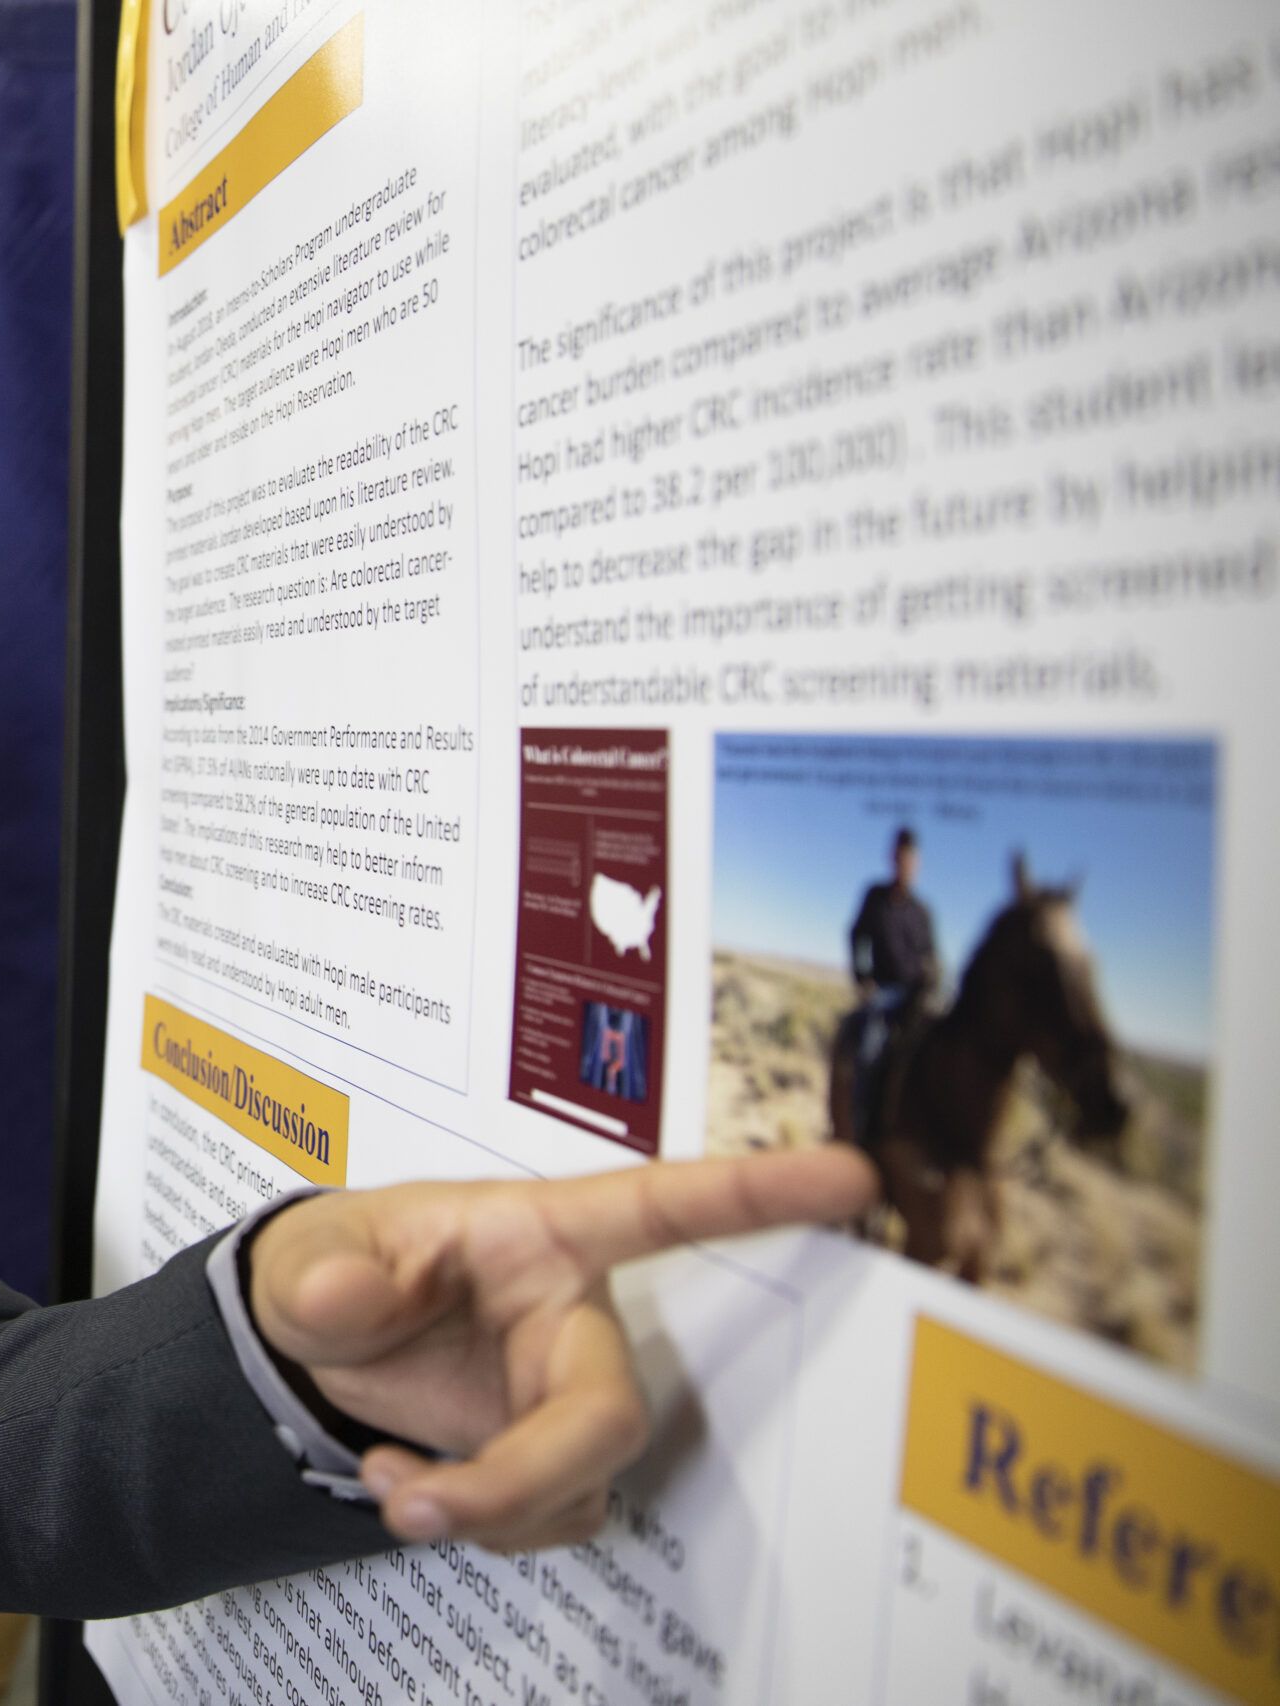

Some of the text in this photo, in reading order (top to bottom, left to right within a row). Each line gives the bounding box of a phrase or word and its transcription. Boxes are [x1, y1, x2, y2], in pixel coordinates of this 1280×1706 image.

[222, 37, 262, 101] Human
[172, 173, 228, 250] Abstract
[290, 265, 331, 306] extensive
[333, 230, 381, 277] literature
[384, 205, 424, 245] review
[428, 189, 447, 219] for
[295, 167, 417, 264] Program undergraduate
[519, 182, 616, 261] colorectal
[273, 229, 450, 351] for the Hopi navigator to use while
[518, 244, 775, 372] The significance of this
[259, 278, 439, 395] audience were Hopi men who are 50
[518, 289, 853, 429] cancer burden compared to
[276, 394, 296, 422] Hopi
[297, 369, 356, 412] Reservation.
[268, 404, 459, 497] to evaluate the readability of the CRC
[518, 440, 561, 485] Hopi
[565, 425, 606, 472] had
[610, 413, 684, 466] higher
[689, 386, 742, 440] CRC
[285, 497, 311, 527] based
[314, 495, 337, 523] upon
[340, 481, 354, 510] his
[357, 472, 408, 506] literature
[411, 457, 455, 489] review.
[518, 460, 758, 541] compared to 38.2 per
[251, 543, 288, 571] materials
[290, 538, 309, 562] that
[311, 534, 334, 556] were
[336, 521, 366, 550] easily
[369, 501, 435, 542] understood
[438, 499, 453, 530] by
[518, 558, 558, 598] help
[561, 560, 583, 589] to
[588, 545, 690, 586] decrease
[694, 530, 739, 571] the
[748, 528, 798, 573] gap
[811, 519, 839, 553] in
[265, 593, 440, 639] read and understood by the target
[277, 576, 316, 606] question
[317, 572, 328, 594] is:
[330, 569, 348, 592] Are
[350, 553, 404, 588] colorectal
[407, 550, 453, 578] cancer-
[520, 613, 631, 651] understand
[634, 604, 673, 641] the
[683, 597, 843, 644] importance
[520, 672, 540, 707] of
[544, 667, 711, 707] understandable
[719, 662, 774, 705] CRC
[271, 725, 327, 747] Government
[330, 724, 397, 750] Performance
[400, 724, 422, 750] and
[426, 724, 474, 752] Results
[297, 767, 320, 785] were
[323, 769, 335, 791] up
[337, 767, 348, 788] to
[350, 764, 375, 790] date
[378, 766, 401, 792] with
[405, 768, 430, 794] CRC
[268, 797, 461, 842] the general population of the United
[261, 867, 444, 931] and to increase CRC screening rates.
[265, 836, 443, 885] research may help to better inform
[257, 940, 451, 1025] evaluated with Hopi male participants
[265, 973, 351, 1029] by Hopi adult men.
[153, 1021, 330, 1166] Conclusion/Discussion
[237, 1161, 274, 1200] printed
[964, 1397, 1280, 1660] Refere
[217, 1625, 263, 1705] adequate
[253, 1632, 283, 1687] grade
[296, 1587, 383, 1706] that although
[367, 1565, 461, 1698] is important
[368, 1619, 416, 1702] before
[409, 1558, 514, 1697] that subject.
[504, 1600, 550, 1666] such
